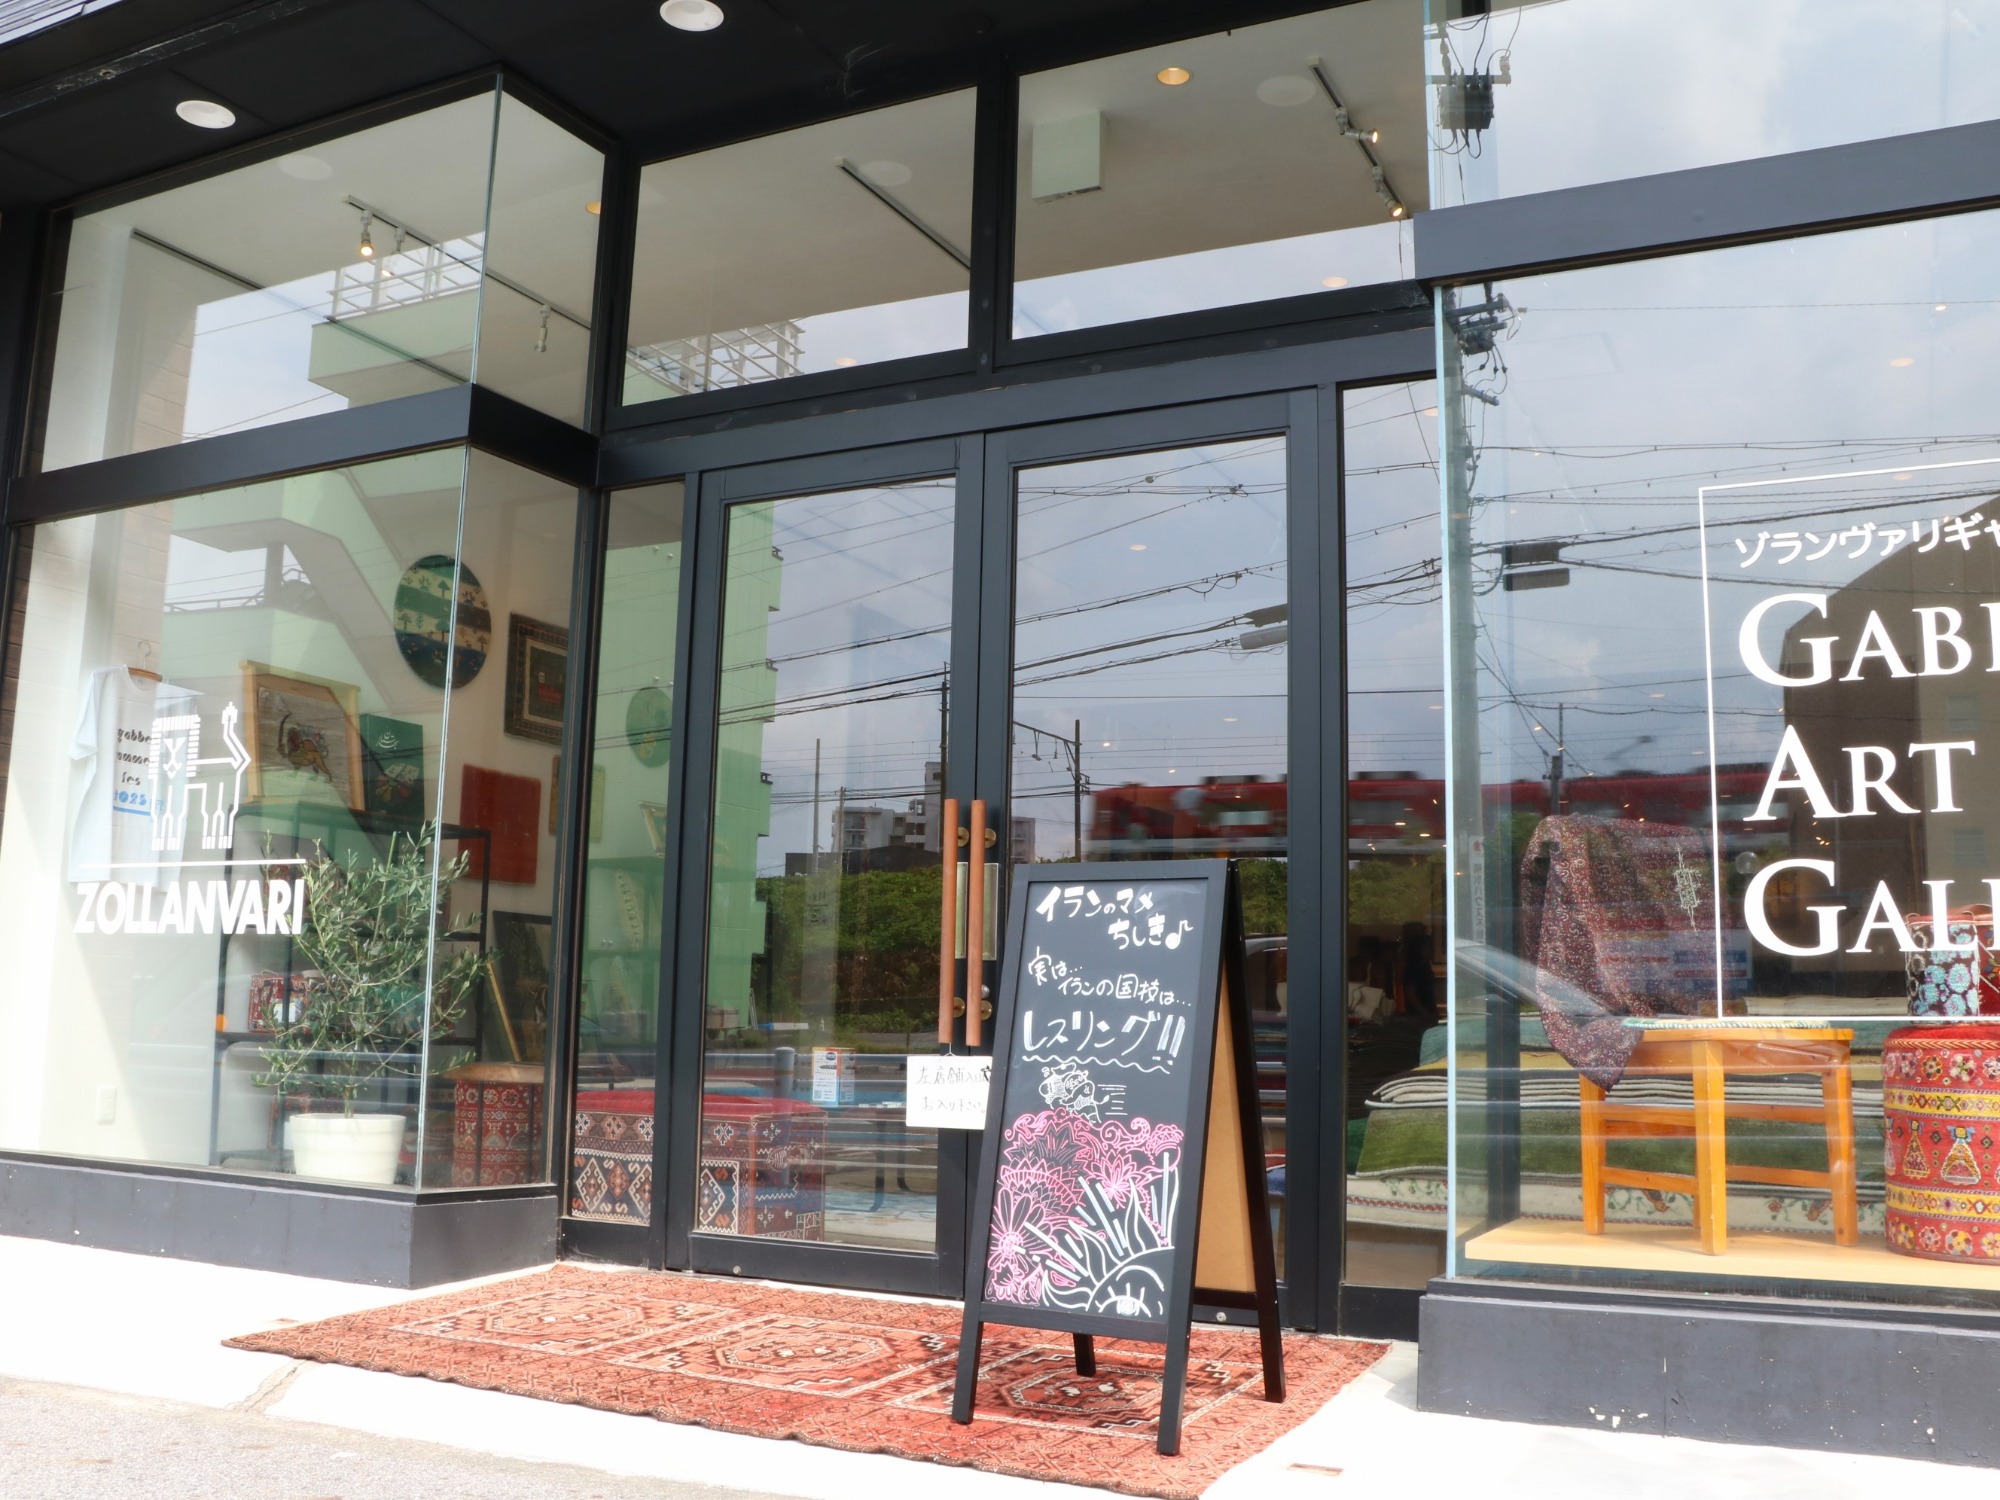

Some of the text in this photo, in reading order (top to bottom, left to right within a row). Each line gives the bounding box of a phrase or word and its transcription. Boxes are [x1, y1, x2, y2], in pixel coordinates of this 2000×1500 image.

[1743, 724, 1976, 823] ART
[73, 879, 304, 935] ZOLLANVARI
[1036, 885, 1154, 923] イランのマメ
